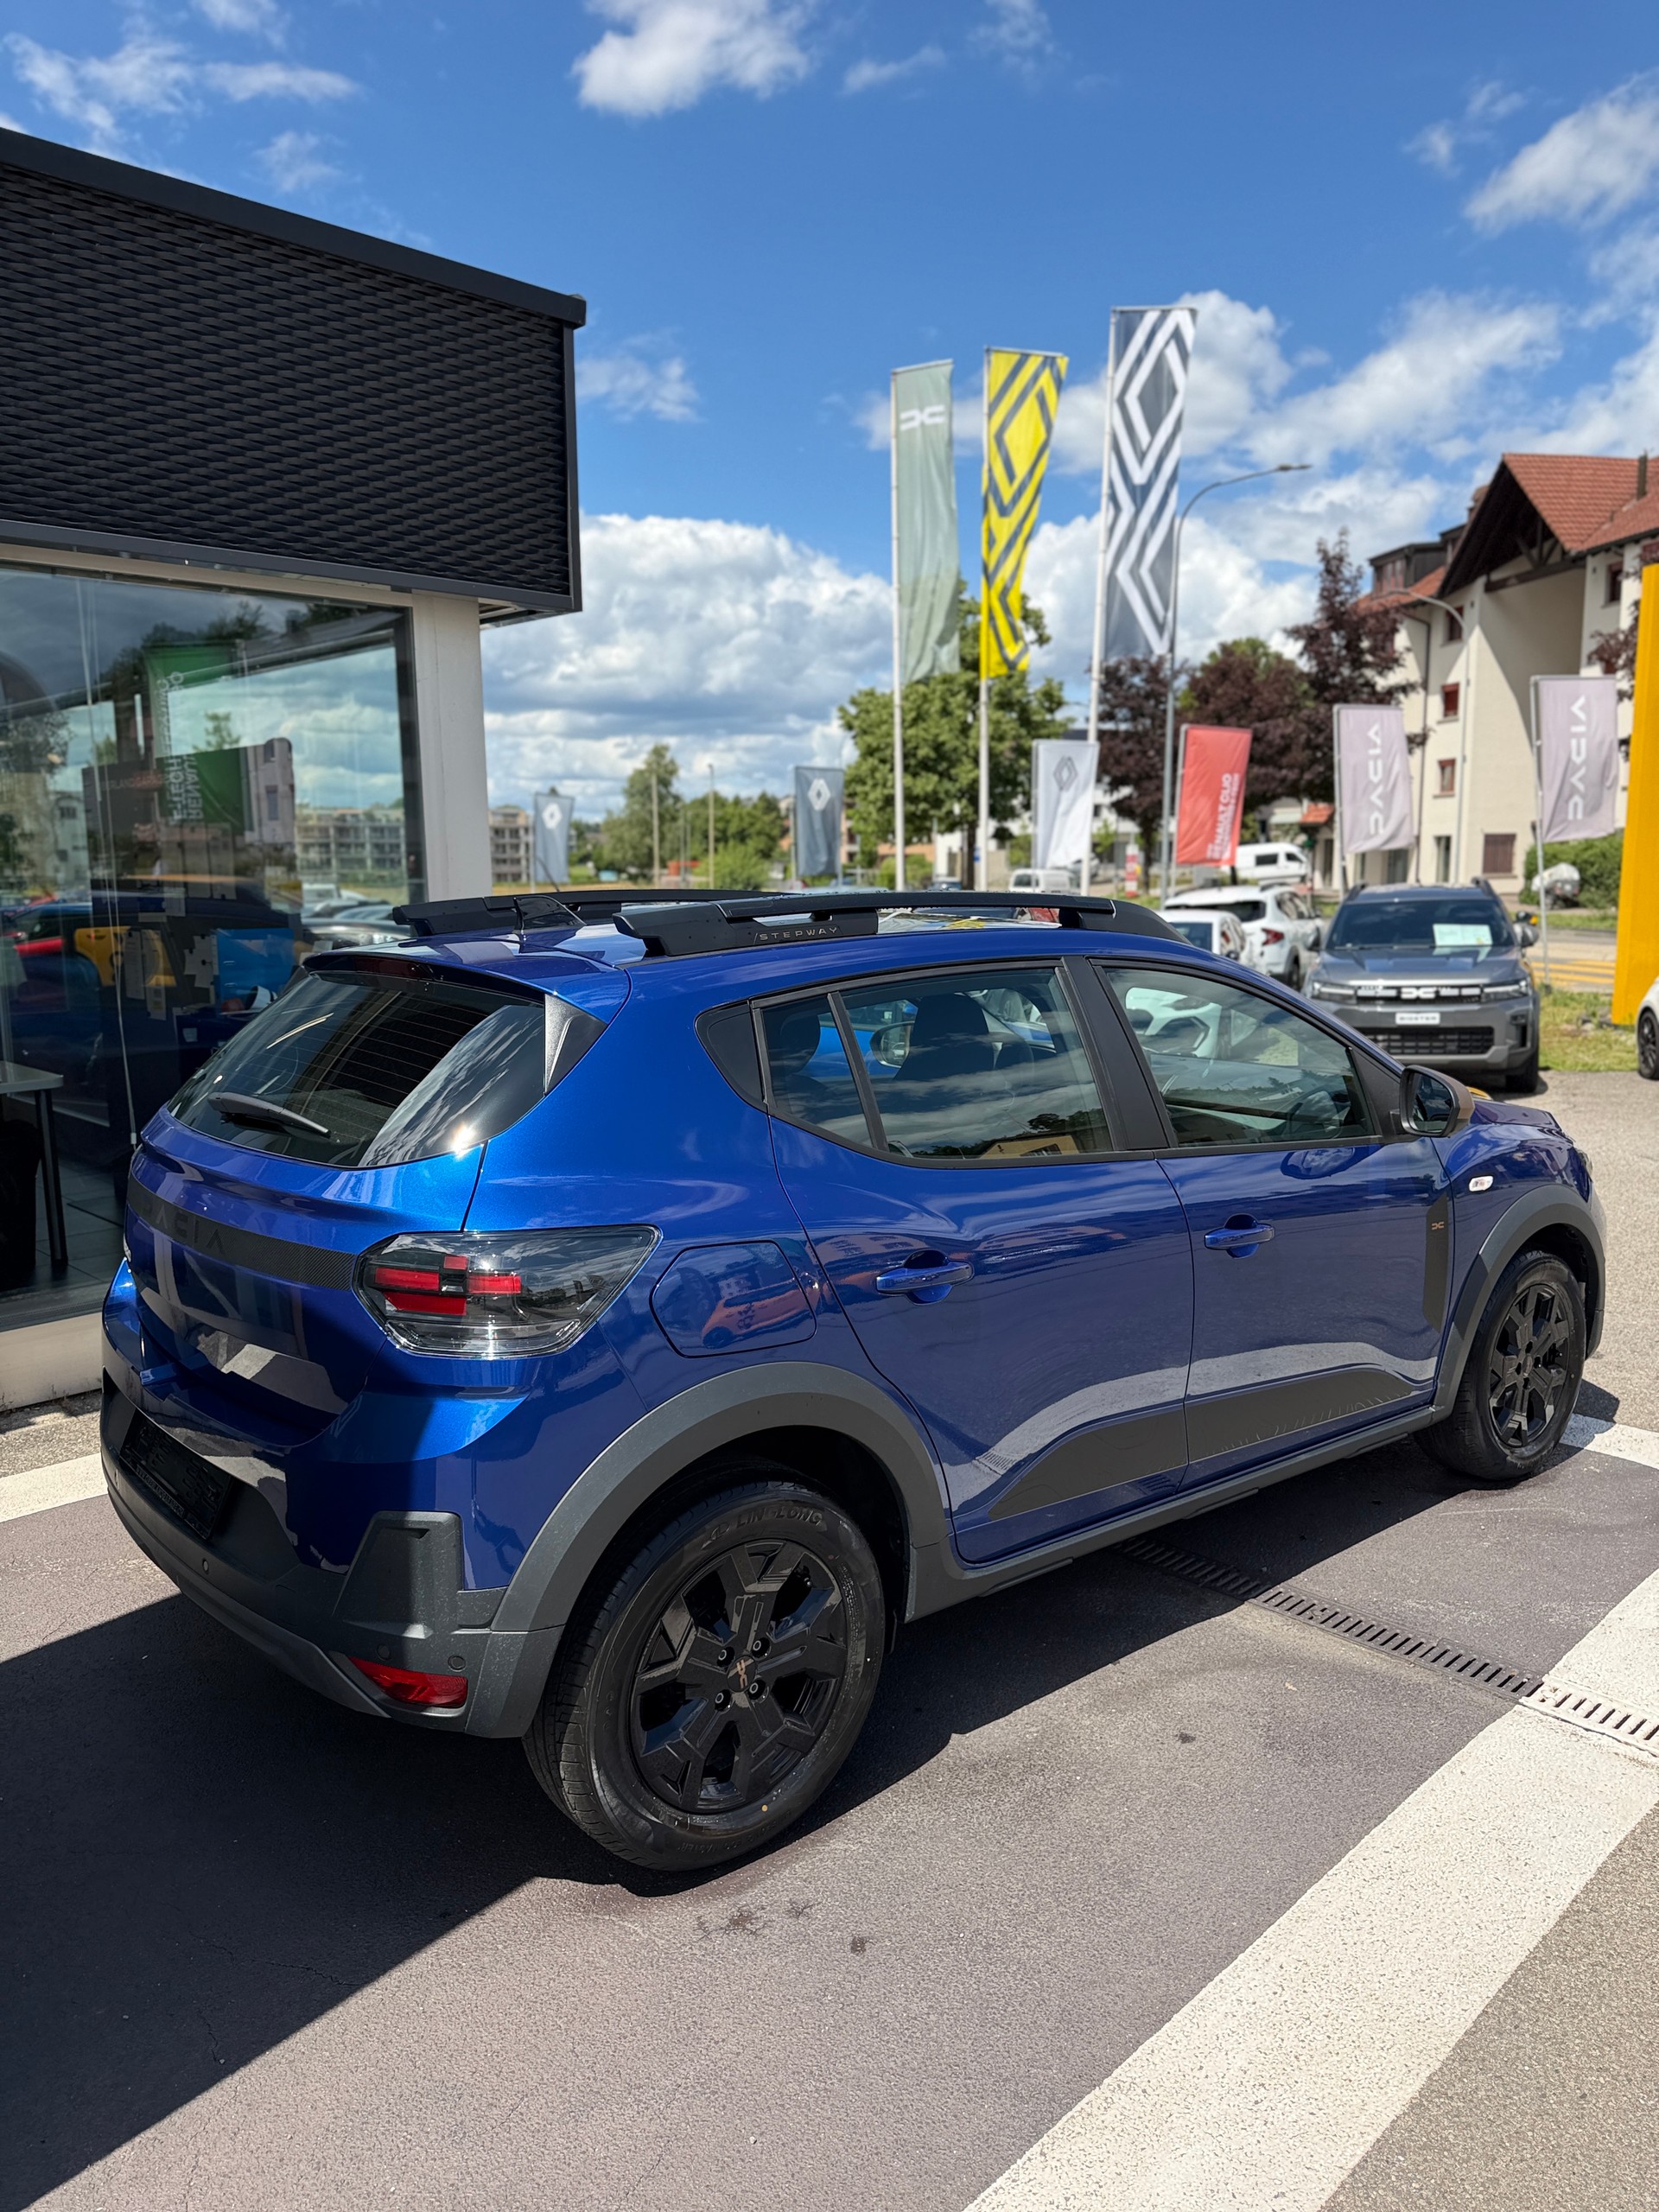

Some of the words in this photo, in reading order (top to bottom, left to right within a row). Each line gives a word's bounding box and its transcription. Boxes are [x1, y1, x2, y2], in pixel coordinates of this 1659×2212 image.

[1367, 722, 1384, 836] DACIA
[1568, 695, 1586, 821] DACIA
[759, 927, 837, 941] STEPWAY
